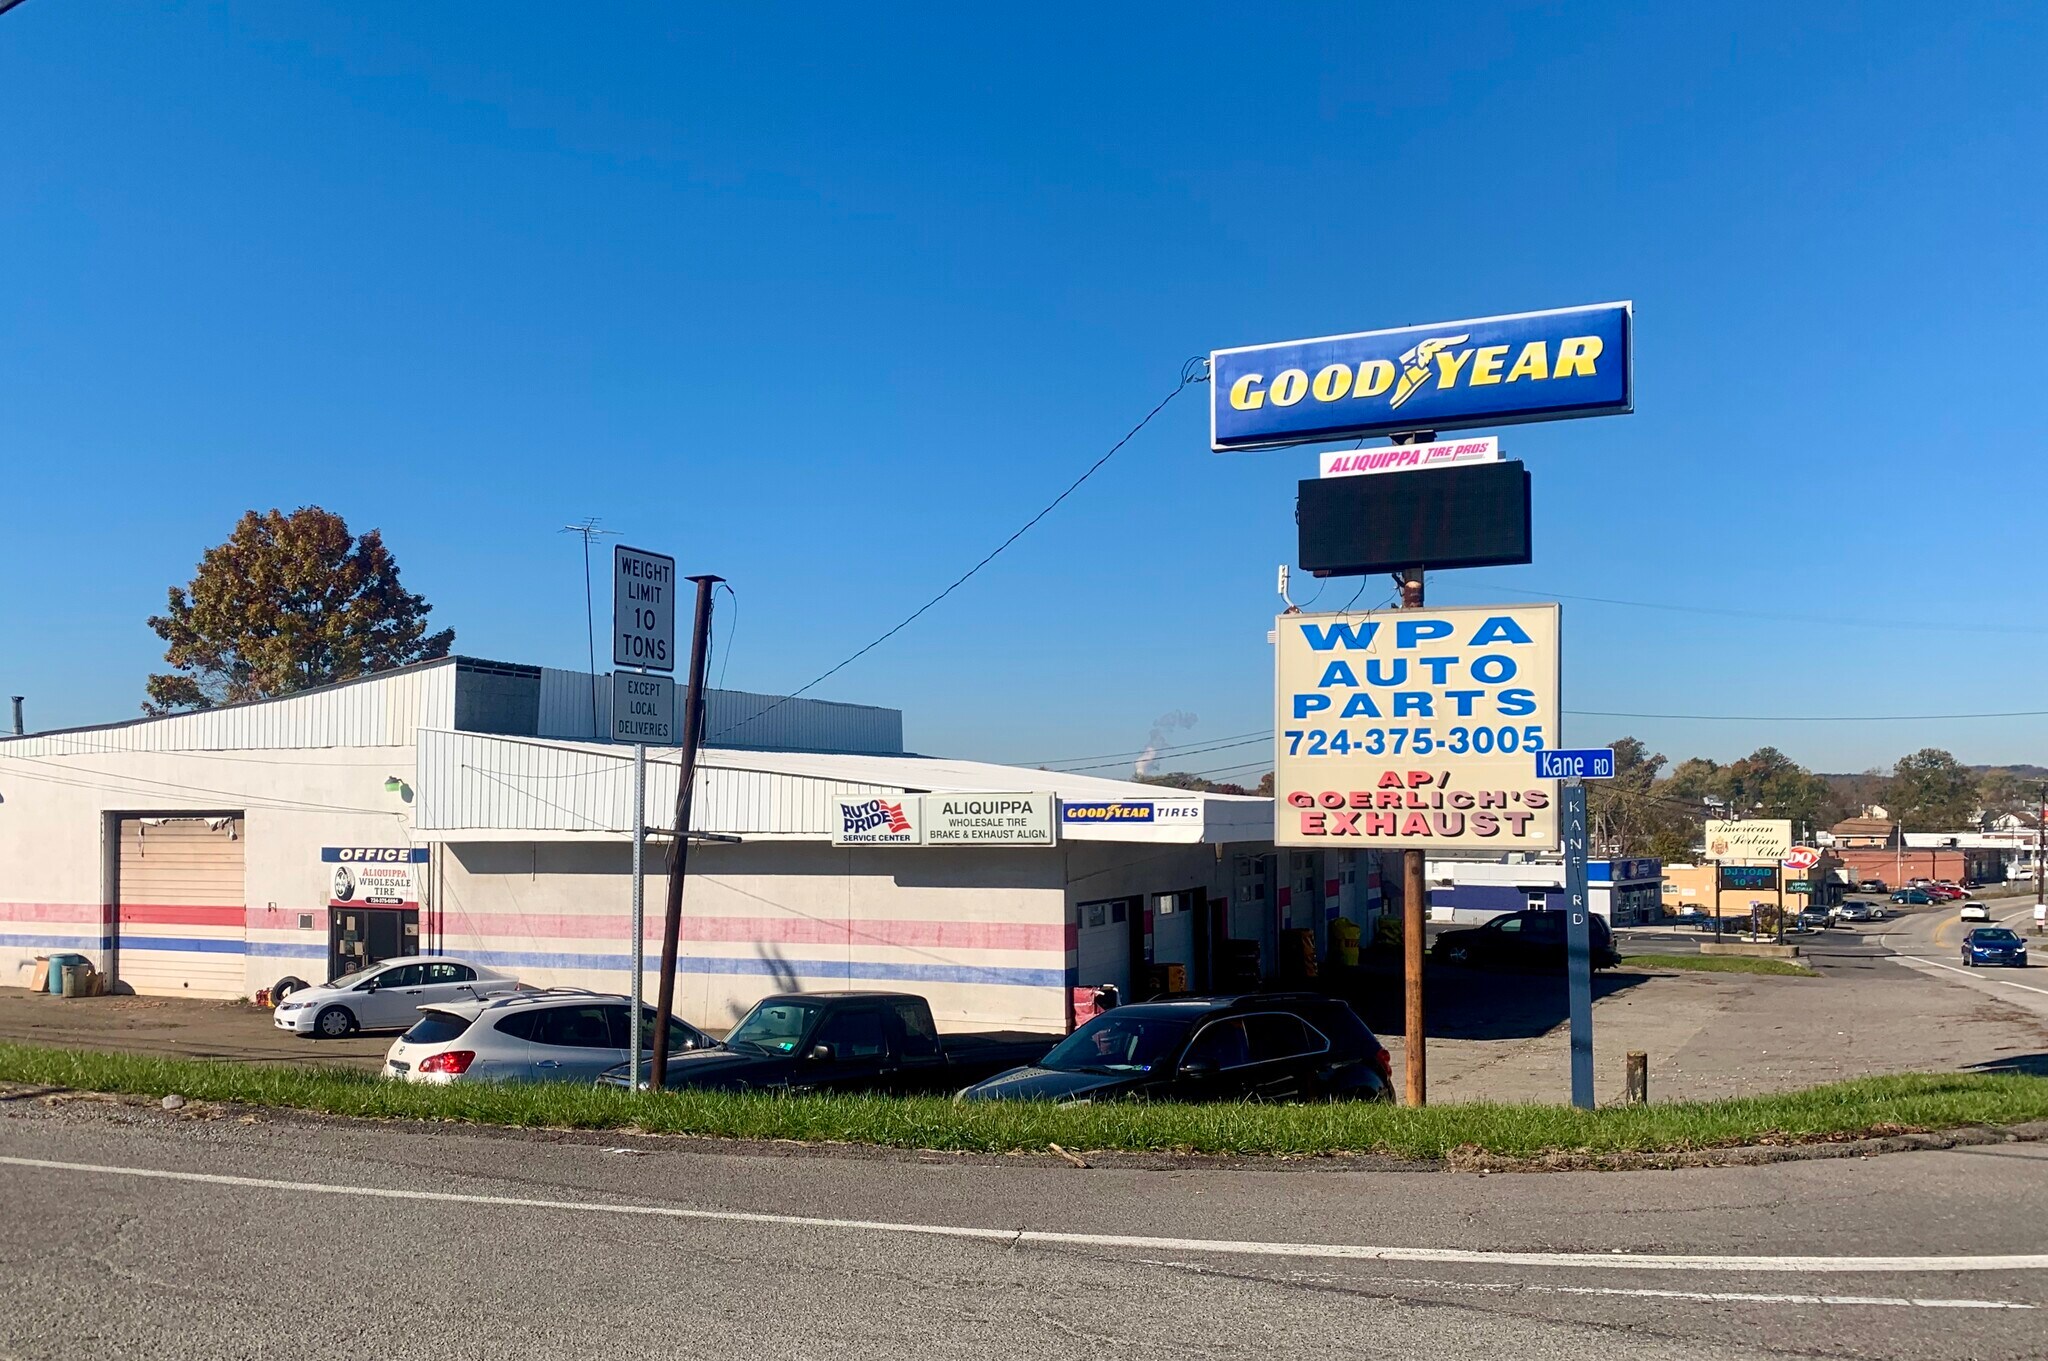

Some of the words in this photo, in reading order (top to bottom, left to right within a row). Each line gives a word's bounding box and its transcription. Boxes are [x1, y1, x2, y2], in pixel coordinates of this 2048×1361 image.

[1328, 449, 1421, 473] ALIQUIPPA
[1424, 446, 1453, 464] TIRE
[1451, 443, 1489, 461] PROS
[621, 556, 670, 583] WEIGHT
[628, 581, 662, 604] LIMIT
[635, 607, 656, 631] 10
[1299, 616, 1534, 651] WPA
[622, 633, 666, 661] TONS
[1317, 654, 1518, 688] AUTO
[627, 680, 661, 697] EXCEPT
[630, 700, 658, 717] LOCAL
[1293, 688, 1537, 719] PARTS
[618, 719, 669, 737] DELIVERIES
[1284, 725, 1545, 756] 724-375-3005
[1542, 752, 1584, 776] Kane
[1594, 758, 1609, 775] RD
[1377, 770, 1450, 789] AP/
[942, 800, 1034, 815] ALIQUIPPA
[1287, 790, 1550, 810] GOERLICH'S
[840, 799, 880, 819] AUTO
[1157, 807, 1199, 817] TIRES
[843, 809, 893, 834] PRIDE
[949, 818, 1003, 827] WHOLESALE
[1005, 818, 1027, 827] TIRE
[1300, 811, 1535, 837] EXHAUST
[1709, 823, 1773, 833] American
[843, 834, 877, 842] SERVICE
[879, 834, 911, 842] CENTER
[930, 830, 960, 839] BRAKE
[963, 830, 969, 839] &
[972, 830, 1015, 839] EXHAUST
[1018, 829, 1048, 839] ALIGN.
[1730, 833, 1779, 845] Serbian
[339, 849, 409, 861] OFFICE
[1756, 846, 1787, 857] Club
[1787, 851, 1812, 865] DQ
[362, 867, 407, 878] ALIQUIPPA
[1724, 868, 1738, 876] DJ
[1743, 868, 1772, 876] TOAD
[359, 877, 411, 887] WHOLESALE
[1733, 878, 1746, 886] 10
[374, 887, 395, 896] TIRE
